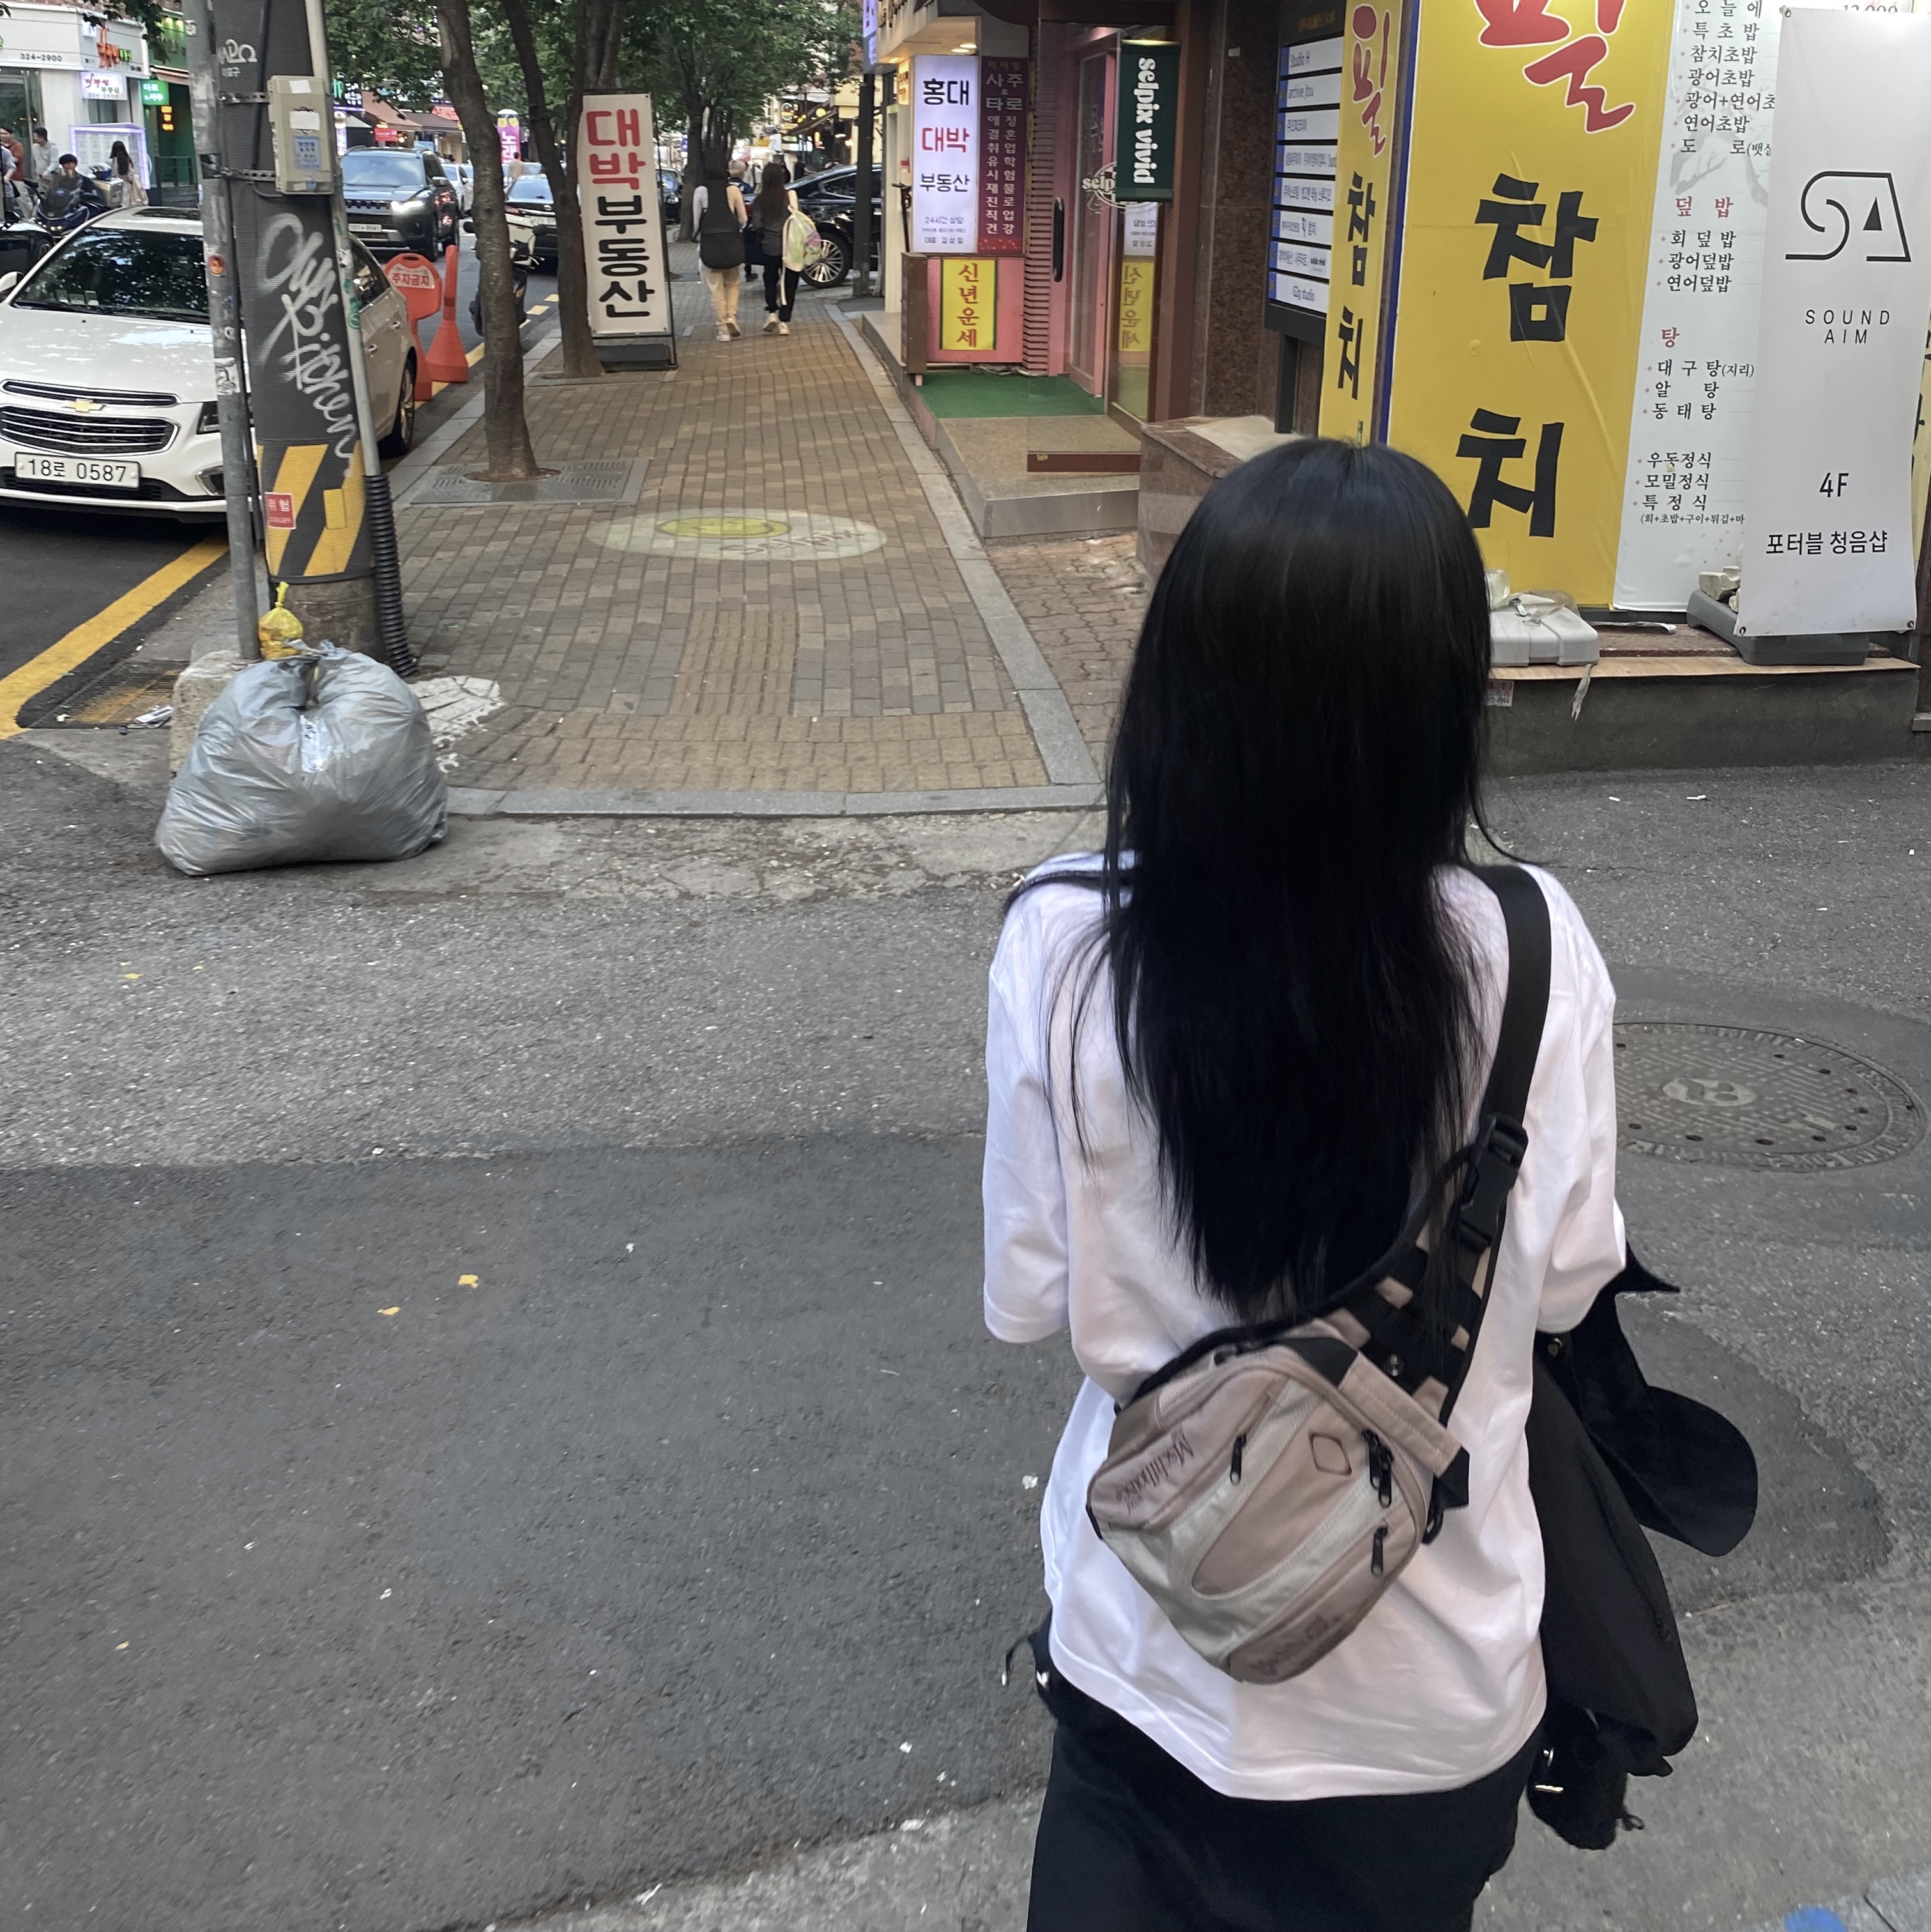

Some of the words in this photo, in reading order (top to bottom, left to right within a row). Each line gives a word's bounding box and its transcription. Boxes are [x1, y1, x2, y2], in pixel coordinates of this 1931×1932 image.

[20, 53, 62, 61] 324-2900
[1691, 45, 1757, 65] 참치초밥
[986, 73, 1024, 88] 사주
[1688, 68, 1755, 87] 광어초밥
[923, 79, 969, 105] 홍대
[1134, 57, 1159, 124] selpix
[985, 97, 1023, 111] 타로
[1684, 114, 1750, 134] 연어초밥
[922, 126, 970, 152] 대박
[1133, 129, 1158, 183] vivid
[920, 174, 970, 192] 부동산
[1668, 252, 1734, 270] 광어덮밥
[1667, 275, 1732, 293] 연어덮밥
[956, 263, 979, 348] 신년운세
[1805, 310, 1890, 325] SOUND
[1661, 327, 1680, 348] 탕
[1824, 329, 1867, 344] AIM
[1647, 452, 1711, 469] 우동정식
[28, 459, 65, 477] 18로
[77, 463, 126, 482] 0587
[1644, 473, 1709, 490] 모밀정식
[1819, 472, 1849, 498] 4F
[1766, 532, 1823, 555] 포터블
[1830, 530, 1888, 554] 청음샵
